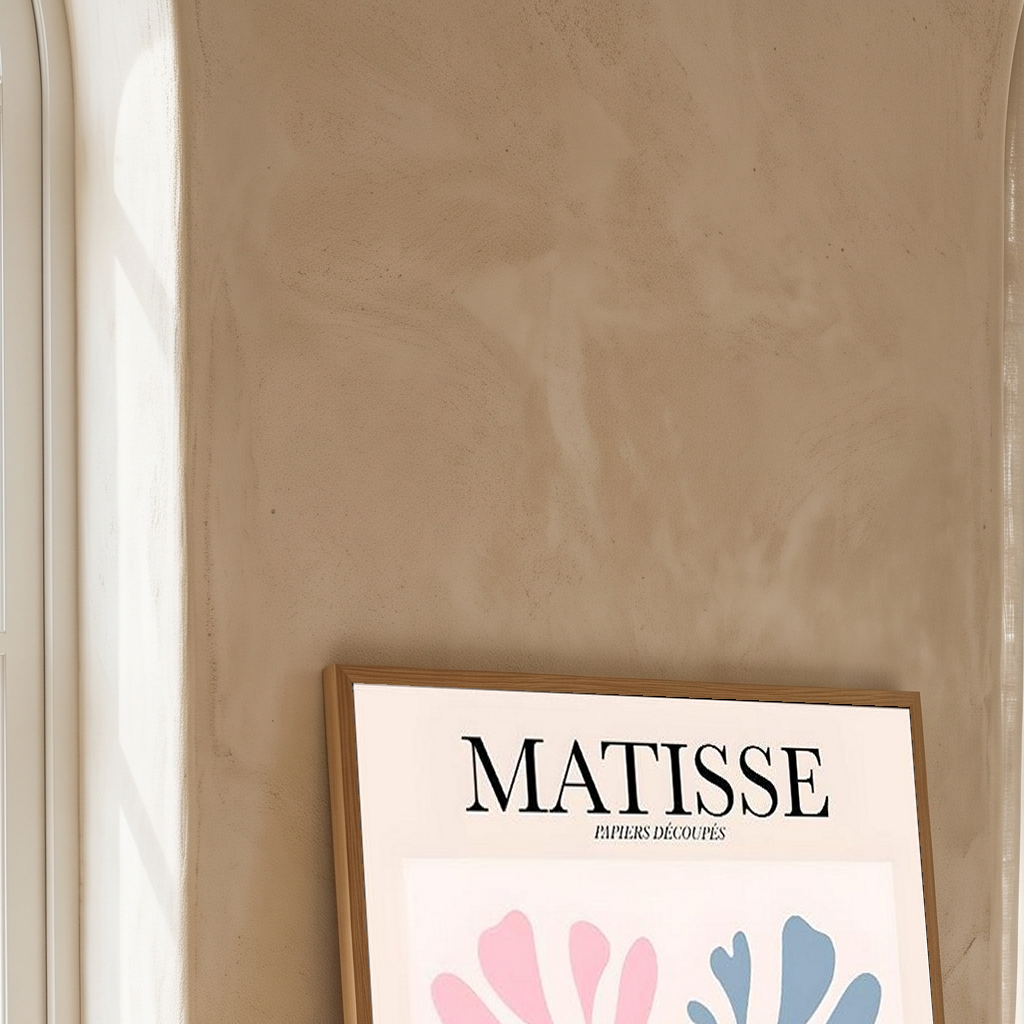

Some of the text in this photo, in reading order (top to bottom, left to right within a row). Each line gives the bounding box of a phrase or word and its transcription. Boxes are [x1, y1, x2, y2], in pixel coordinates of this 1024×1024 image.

[461, 735, 829, 818] MATISSE
[594, 822, 726, 840] PAPIERS DÉCOUPÉS
